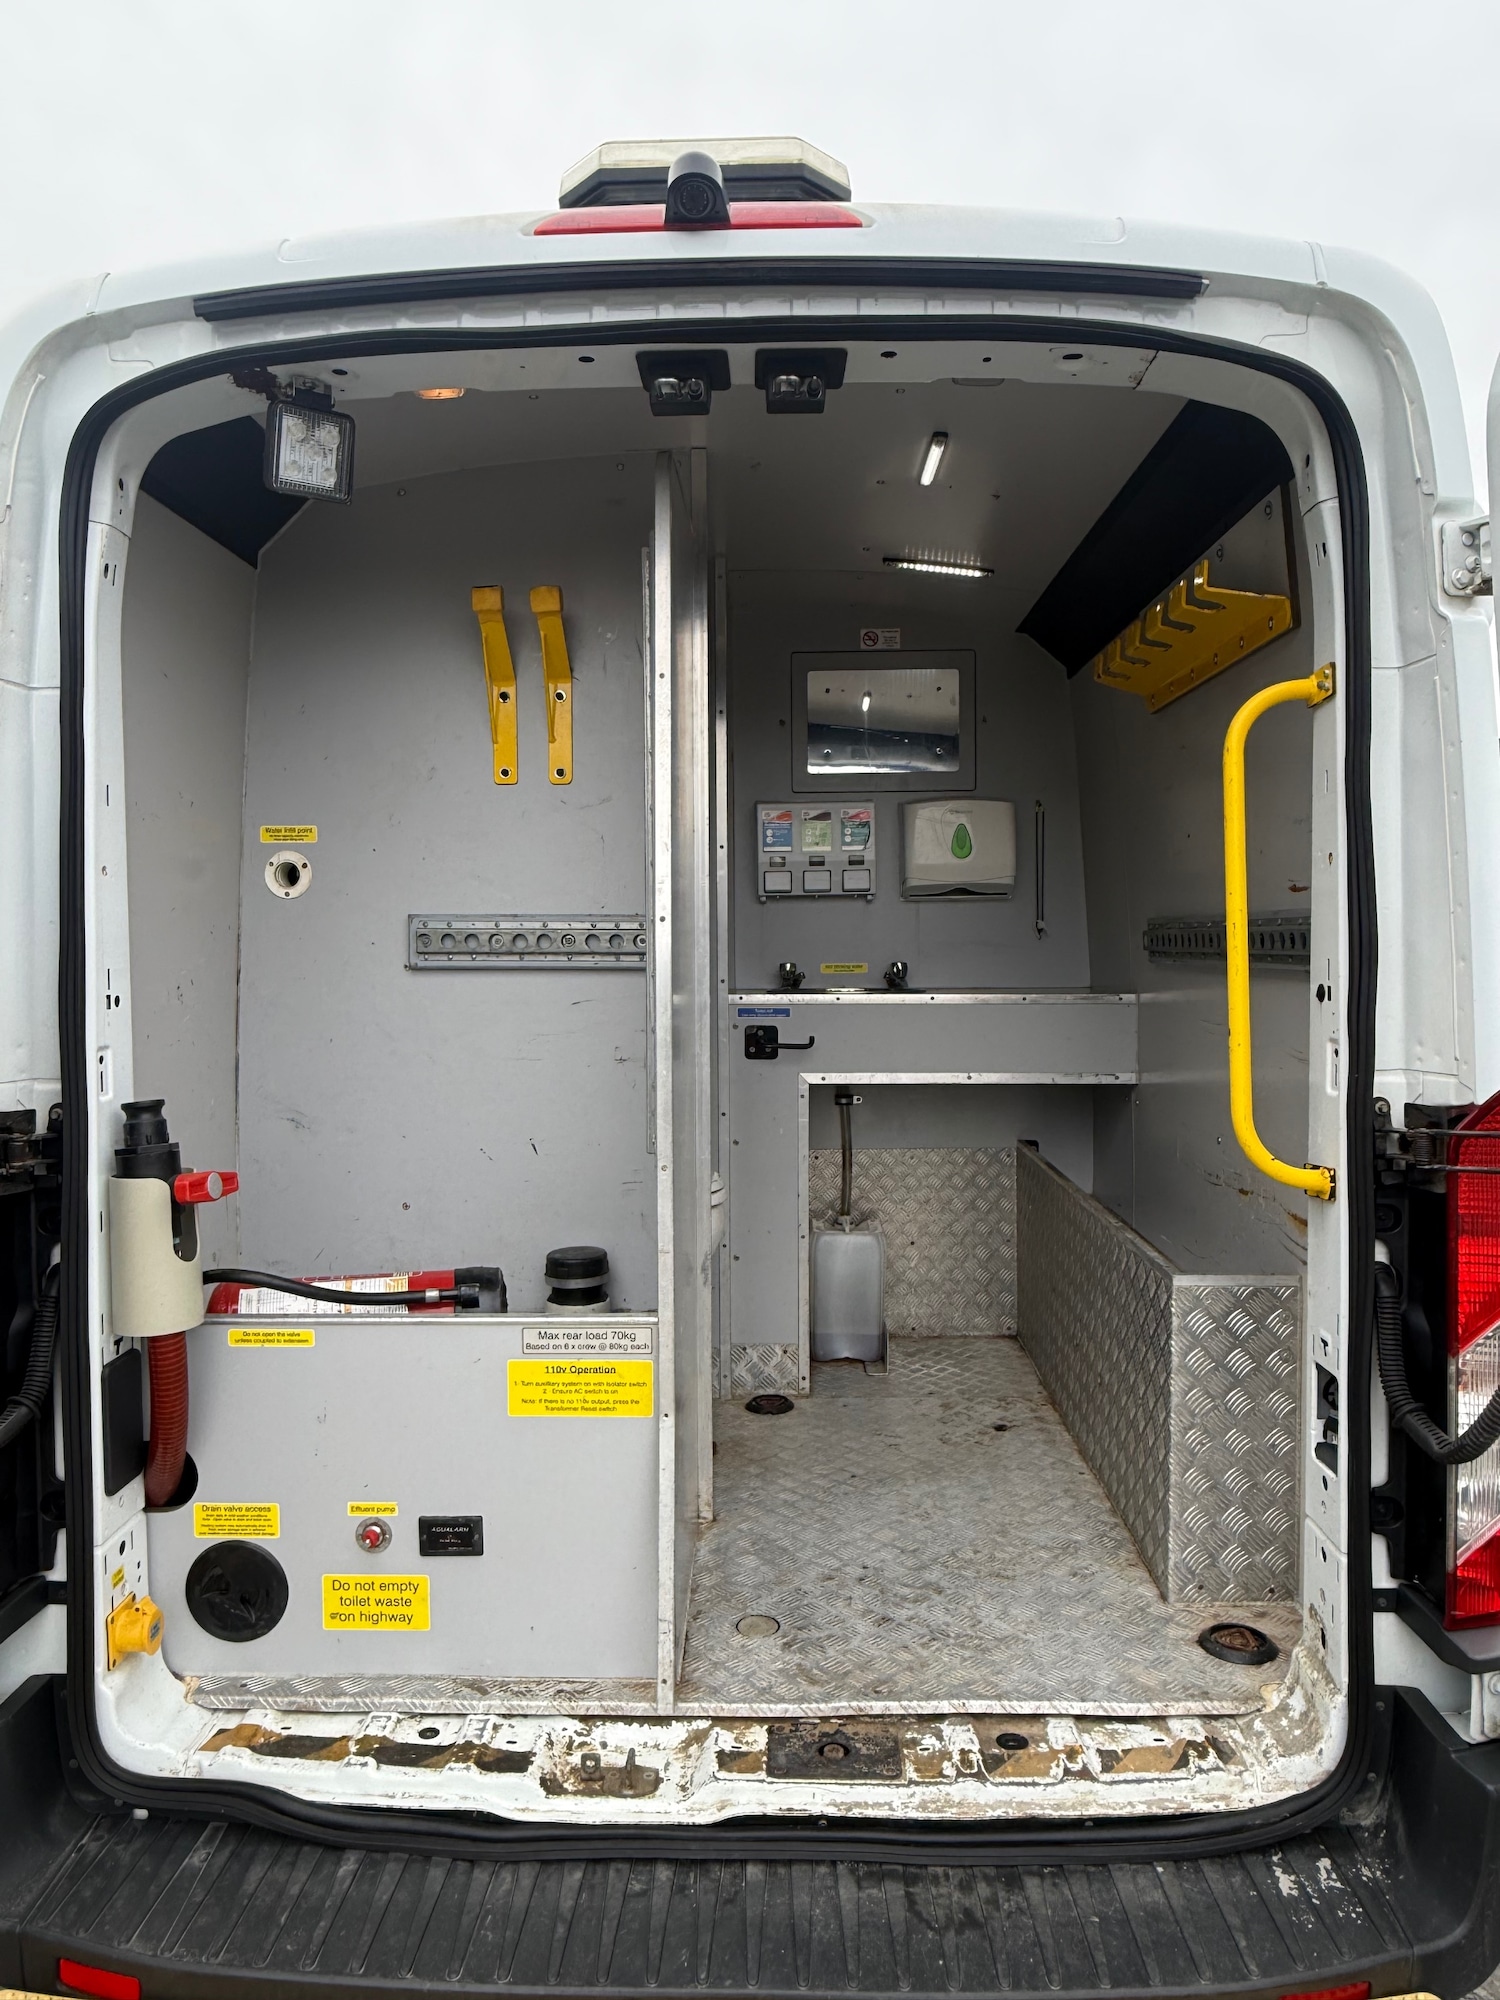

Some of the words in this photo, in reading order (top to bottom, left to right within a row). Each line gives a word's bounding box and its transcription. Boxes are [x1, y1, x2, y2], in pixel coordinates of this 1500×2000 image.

[538, 1331, 559, 1340] Max
[585, 1331, 608, 1340] load
[611, 1331, 636, 1342] 70kg
[599, 1343, 607, 1351] @
[609, 1343, 628, 1351] 80kg
[570, 1366, 616, 1375] Operation
[332, 1580, 350, 1591] Do
[355, 1581, 375, 1591] not
[380, 1581, 419, 1594] empty
[340, 1596, 371, 1606] toilet
[374, 1597, 412, 1606] waste
[339, 1613, 355, 1622] on
[360, 1611, 413, 1625] highway
